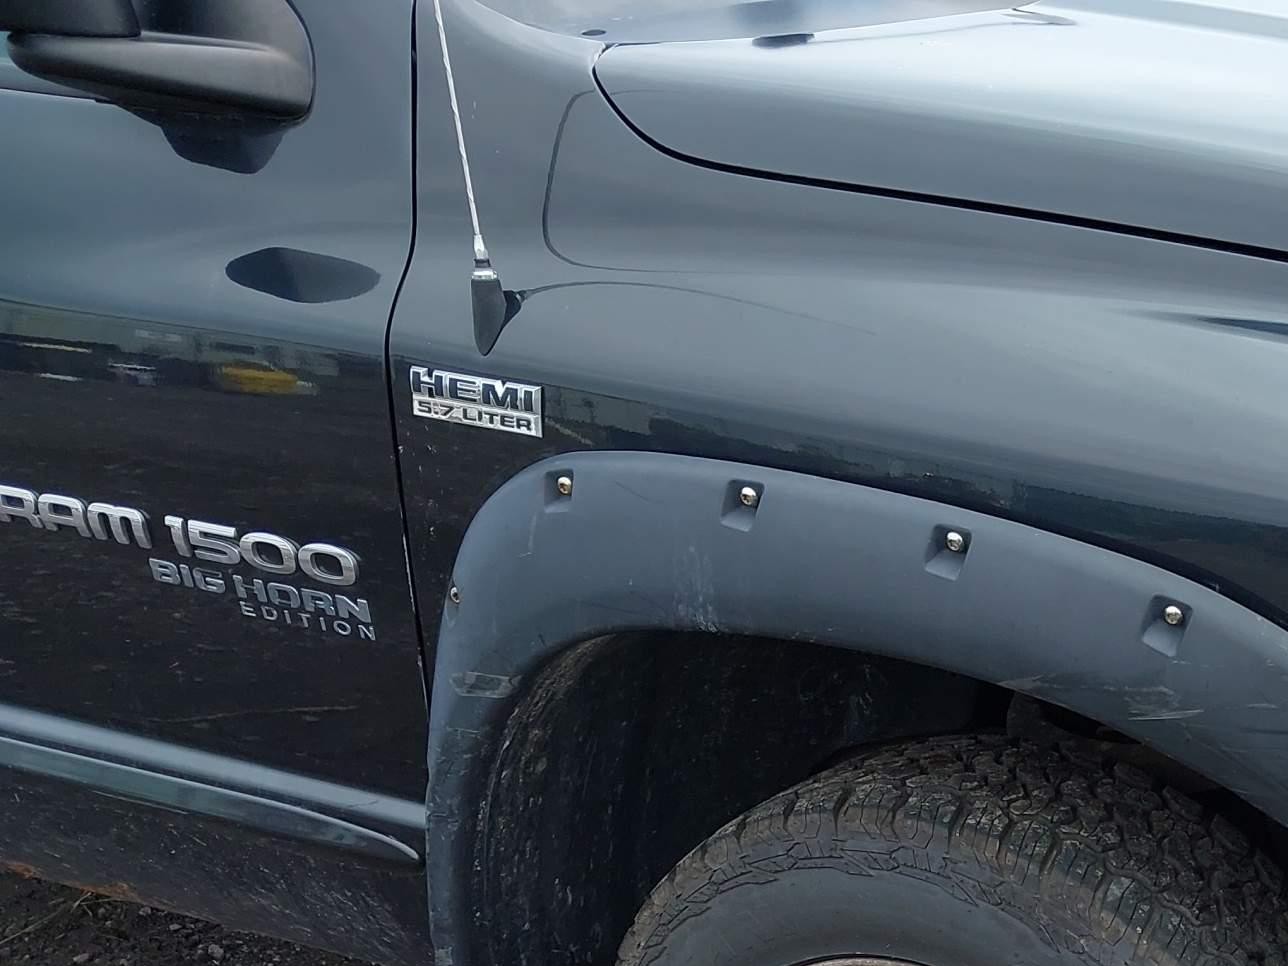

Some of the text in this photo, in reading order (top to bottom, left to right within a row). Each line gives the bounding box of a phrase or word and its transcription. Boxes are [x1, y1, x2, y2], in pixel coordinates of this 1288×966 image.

[410, 365, 542, 414] HEMI
[417, 400, 533, 432] 5.7 LITER
[0, 484, 359, 586] RAM 1500
[149, 557, 372, 623] BIG HORN
[239, 600, 376, 641] EDITION
